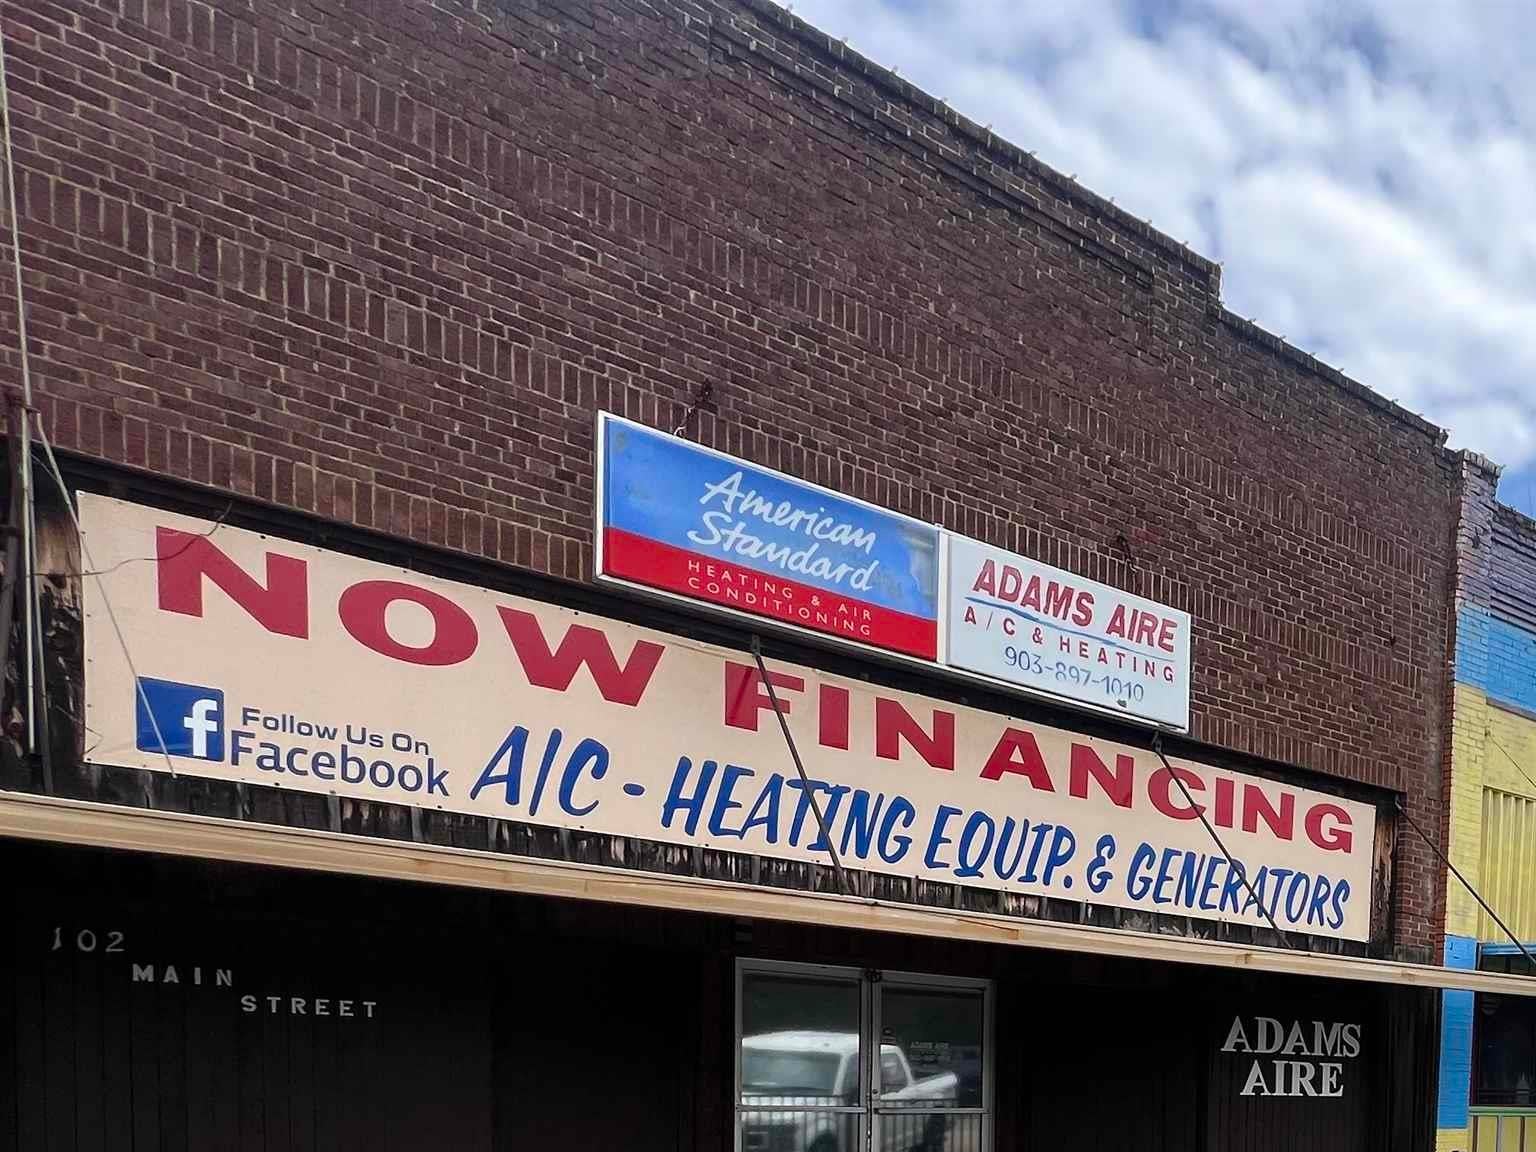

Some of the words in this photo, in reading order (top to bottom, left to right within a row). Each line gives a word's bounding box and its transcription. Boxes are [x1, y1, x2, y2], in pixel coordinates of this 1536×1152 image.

[699, 471, 876, 552] American
[687, 511, 879, 592] Standard
[688, 560, 792, 599] HEATING
[811, 595, 821, 606] &
[838, 603, 872, 621] AIR
[688, 577, 871, 636] CONDITIONING
[972, 559, 1095, 627] ADAMS
[1105, 604, 1178, 653] AIRE
[1005, 646, 1144, 702] 903-897-1010
[1032, 627, 1044, 645] &
[1059, 635, 1174, 683] HEATING
[156, 525, 665, 707] NOW
[725, 661, 1353, 853] FINANCING
[242, 707, 338, 741] Follow
[346, 725, 384, 749] Us
[391, 733, 430, 756] On
[231, 730, 450, 797] Facebook
[470, 725, 609, 816] A/C
[661, 756, 915, 864] HEATING
[924, 804, 1076, 889] EQUIP.
[1086, 834, 1116, 893] &
[1127, 842, 1351, 930] GENERATORS
[52, 927, 125, 952] 102
[132, 963, 232, 987] MAIN
[241, 995, 377, 1018] STREET
[1220, 1015, 1361, 1057] ADAMS
[1240, 1059, 1344, 1097] AIRE
